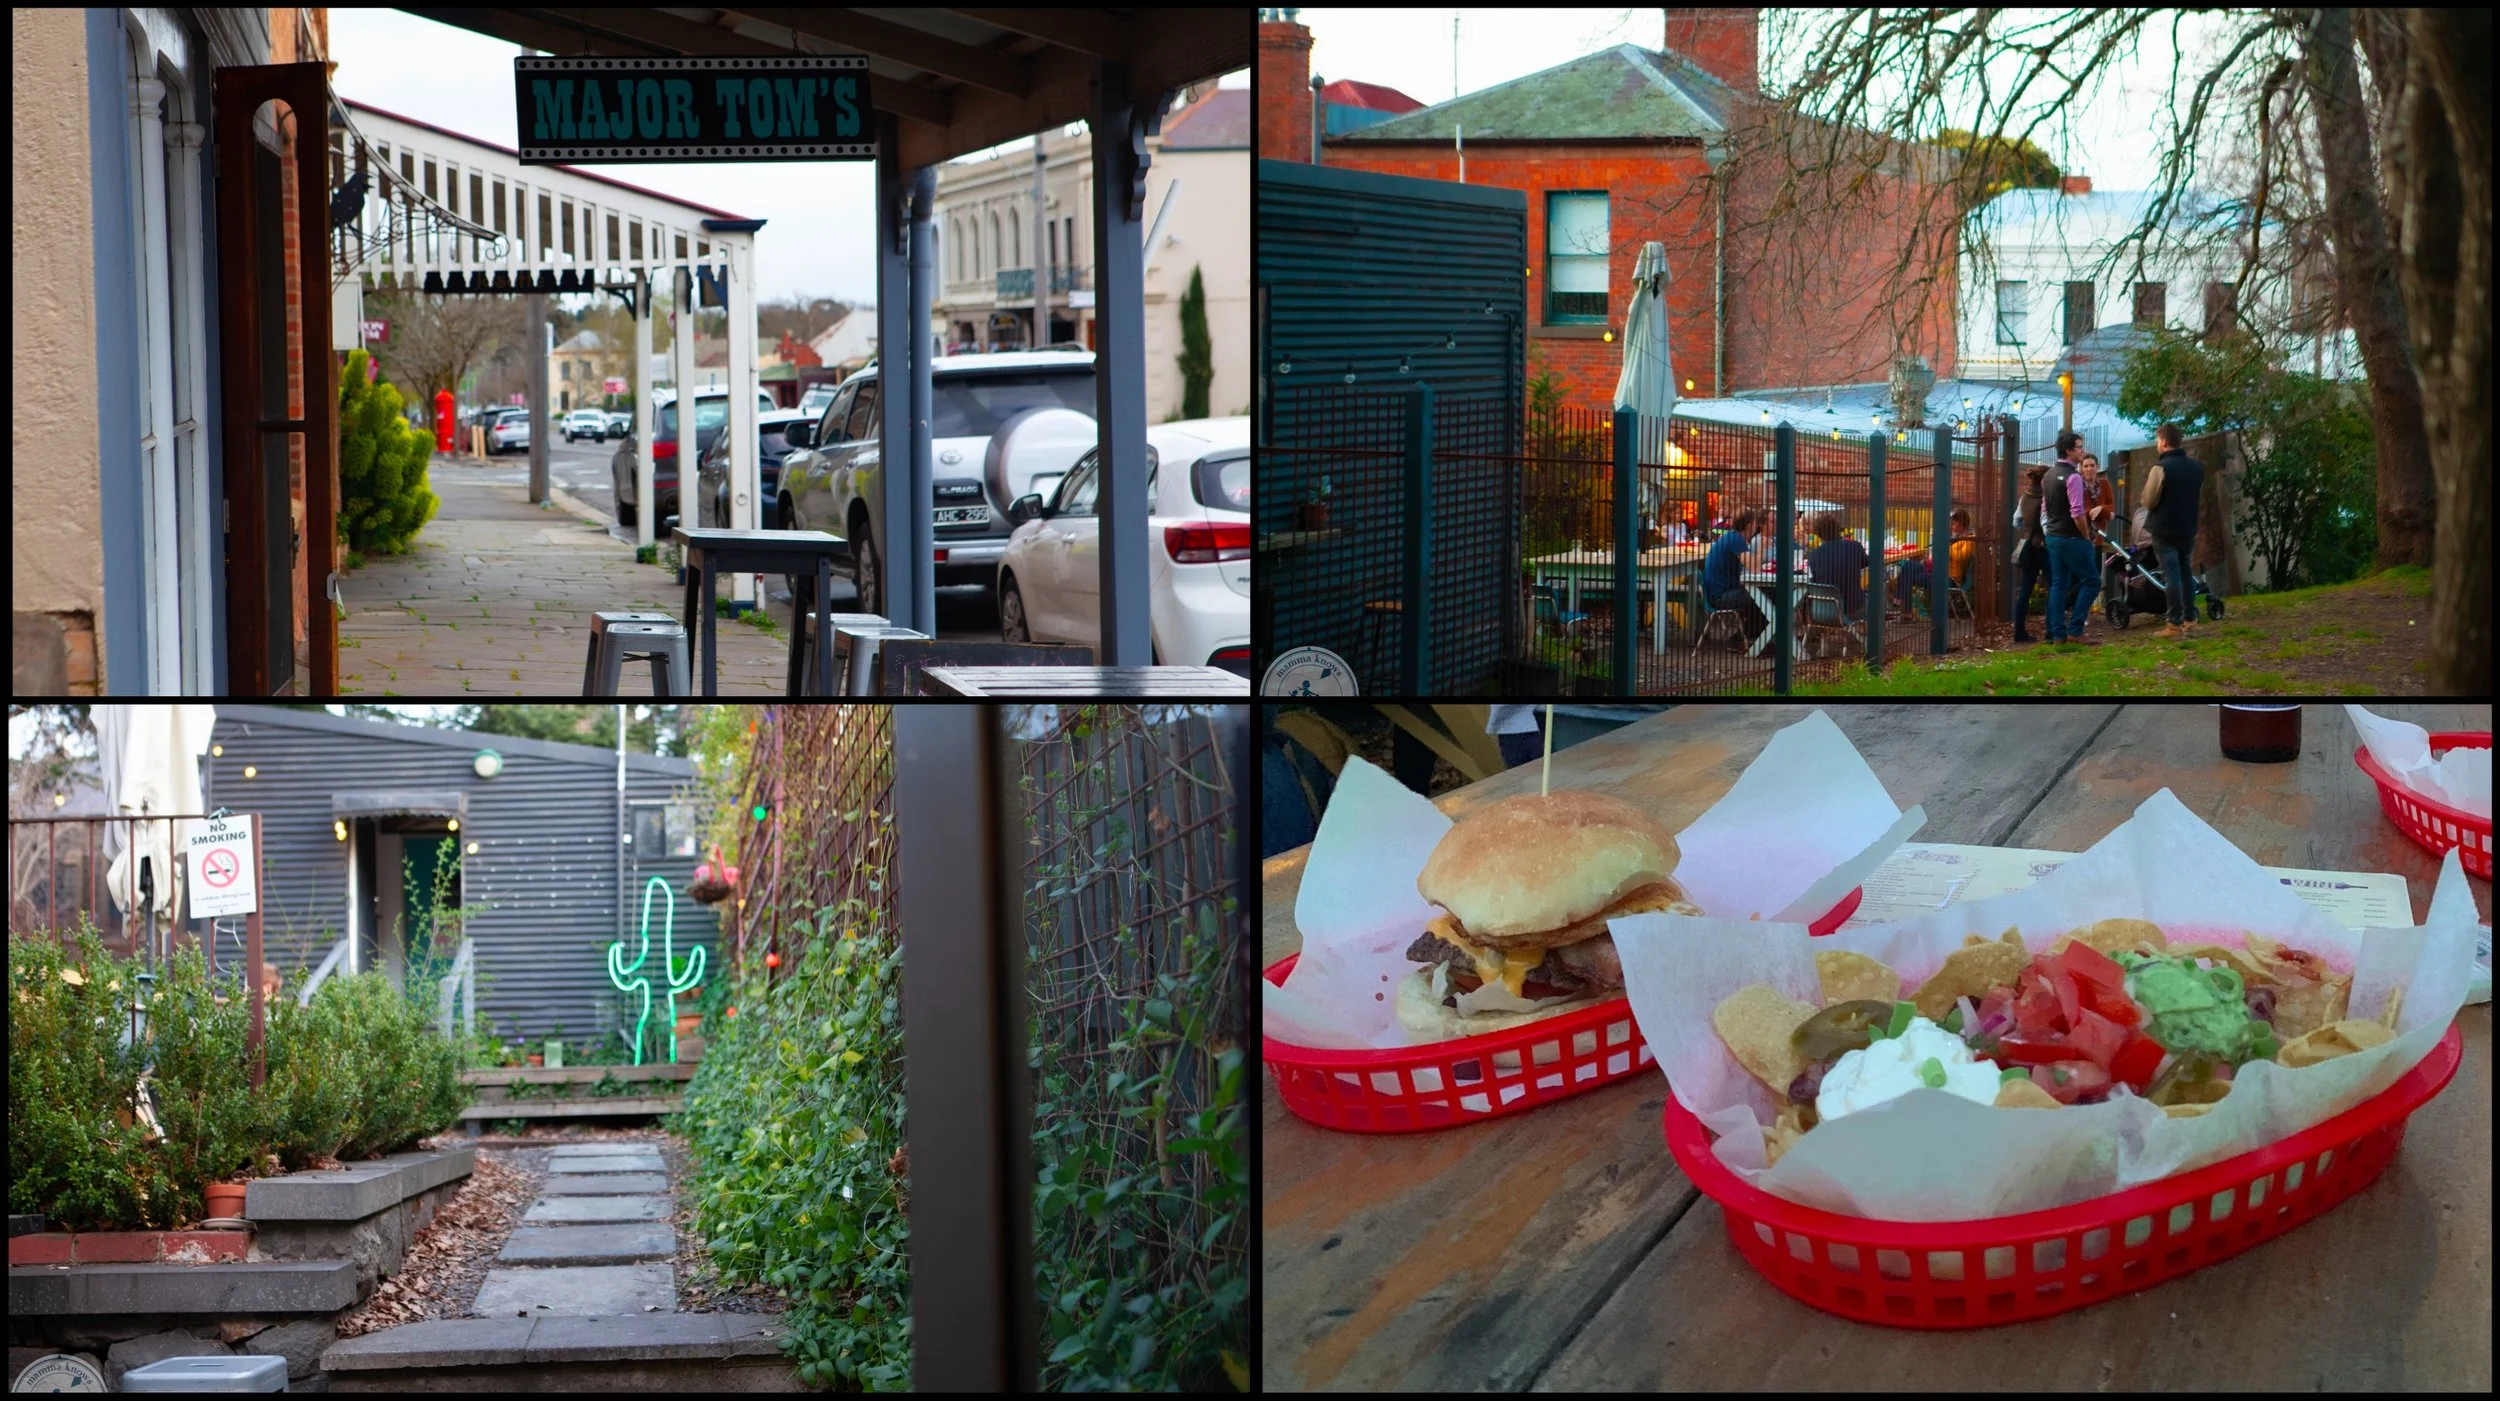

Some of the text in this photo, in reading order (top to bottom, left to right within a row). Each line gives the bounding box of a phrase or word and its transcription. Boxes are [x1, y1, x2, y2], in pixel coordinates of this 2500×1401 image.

[532, 76, 861, 140] MAJOR TOM'S
[209, 823, 227, 833] NO
[191, 831, 247, 846] SMOKING
